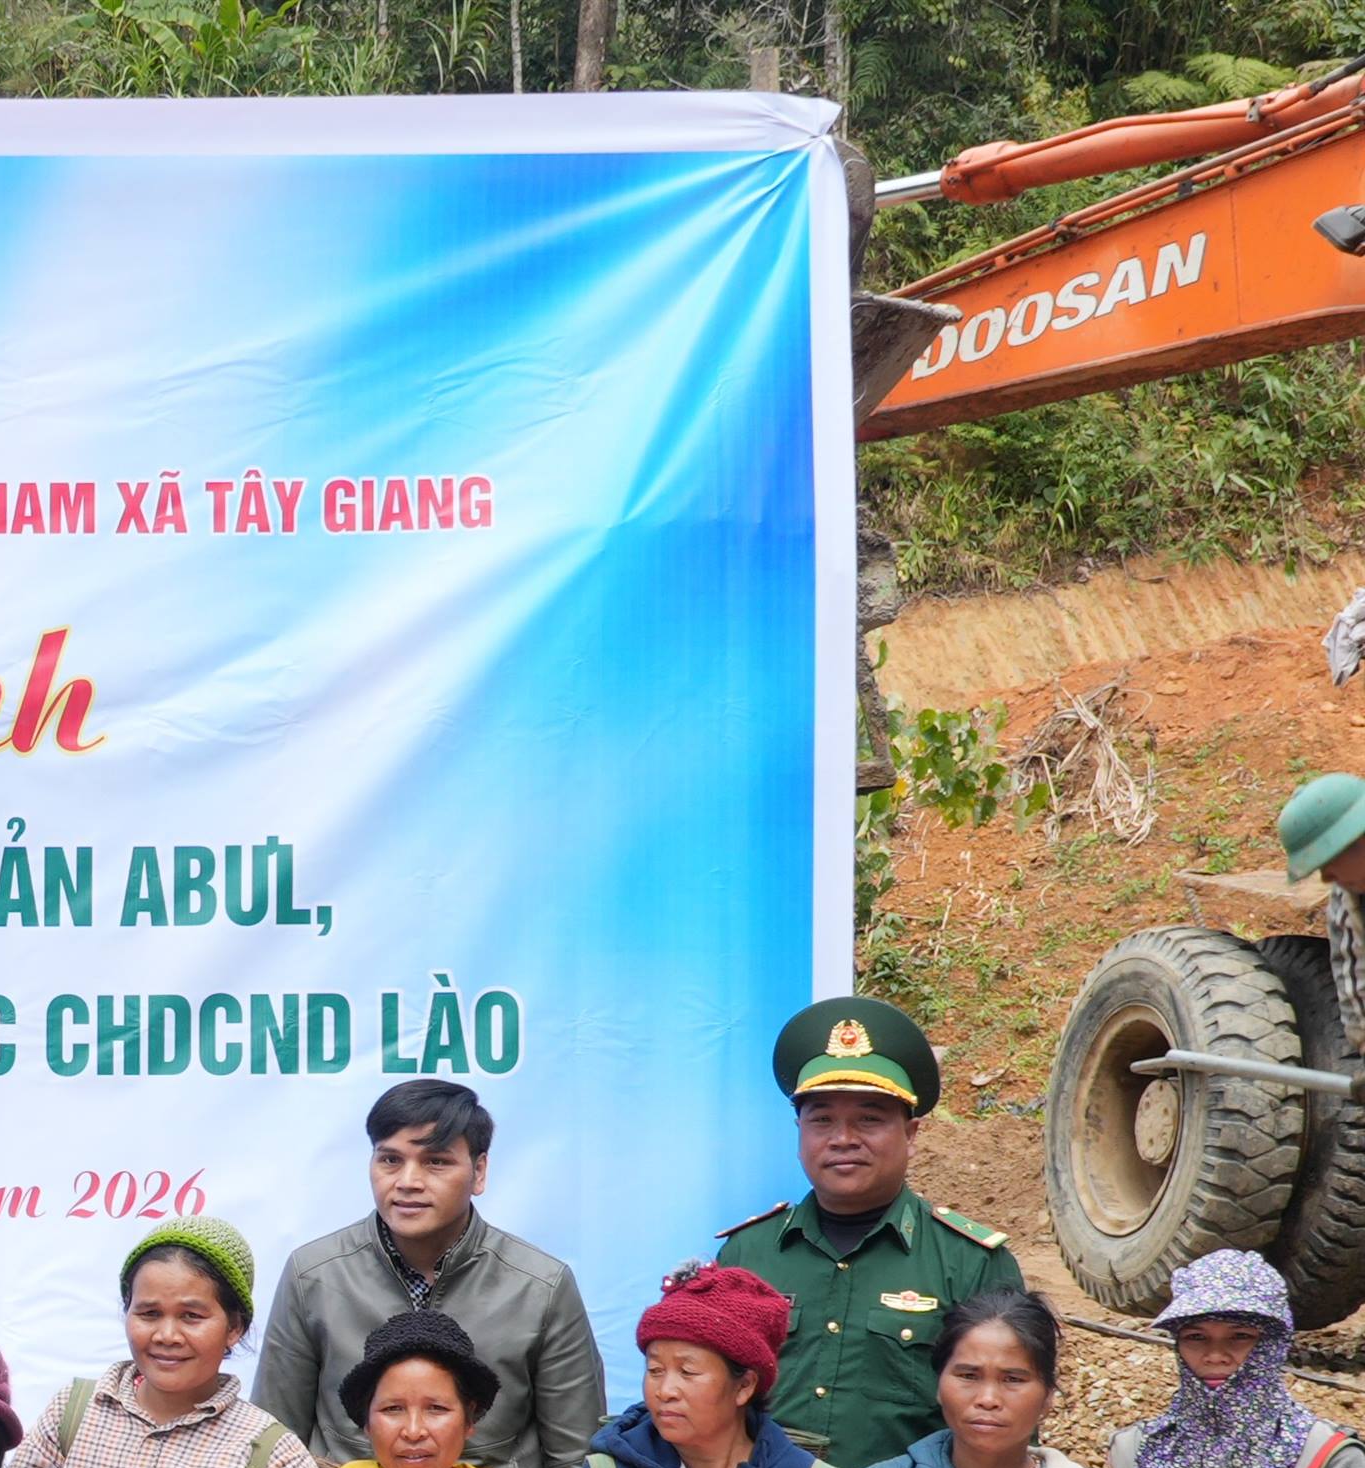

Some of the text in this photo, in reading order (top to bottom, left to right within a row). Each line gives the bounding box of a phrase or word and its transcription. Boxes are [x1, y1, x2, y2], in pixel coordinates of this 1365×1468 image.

[911, 232, 1206, 382] DOOSAN
[115, 472, 187, 534] XÃ
[205, 470, 305, 533] TÂY
[323, 477, 493, 532] GIANG
[46, 993, 351, 1076] CHDCND
[381, 972, 521, 1074] LÀO
[66, 1167, 207, 1218] 2026
